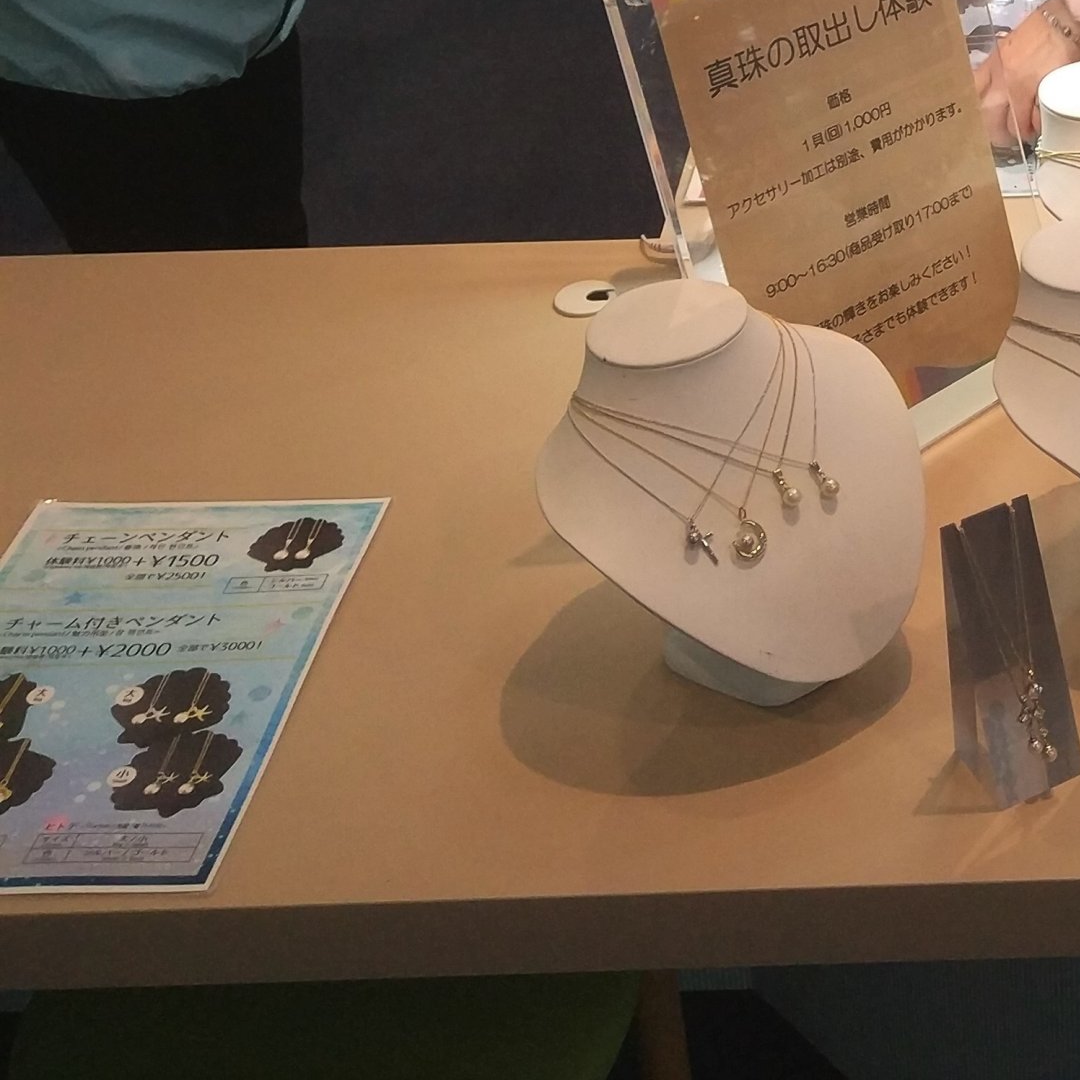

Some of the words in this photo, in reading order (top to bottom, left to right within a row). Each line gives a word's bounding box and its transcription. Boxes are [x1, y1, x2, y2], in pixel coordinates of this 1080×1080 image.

[826, 88, 852, 110] 価格
[844, 194, 891, 228] 営業時間
[62, 530, 229, 545] チェーンペンダント
[6, 613, 221, 631] チャーム付きペンダント
